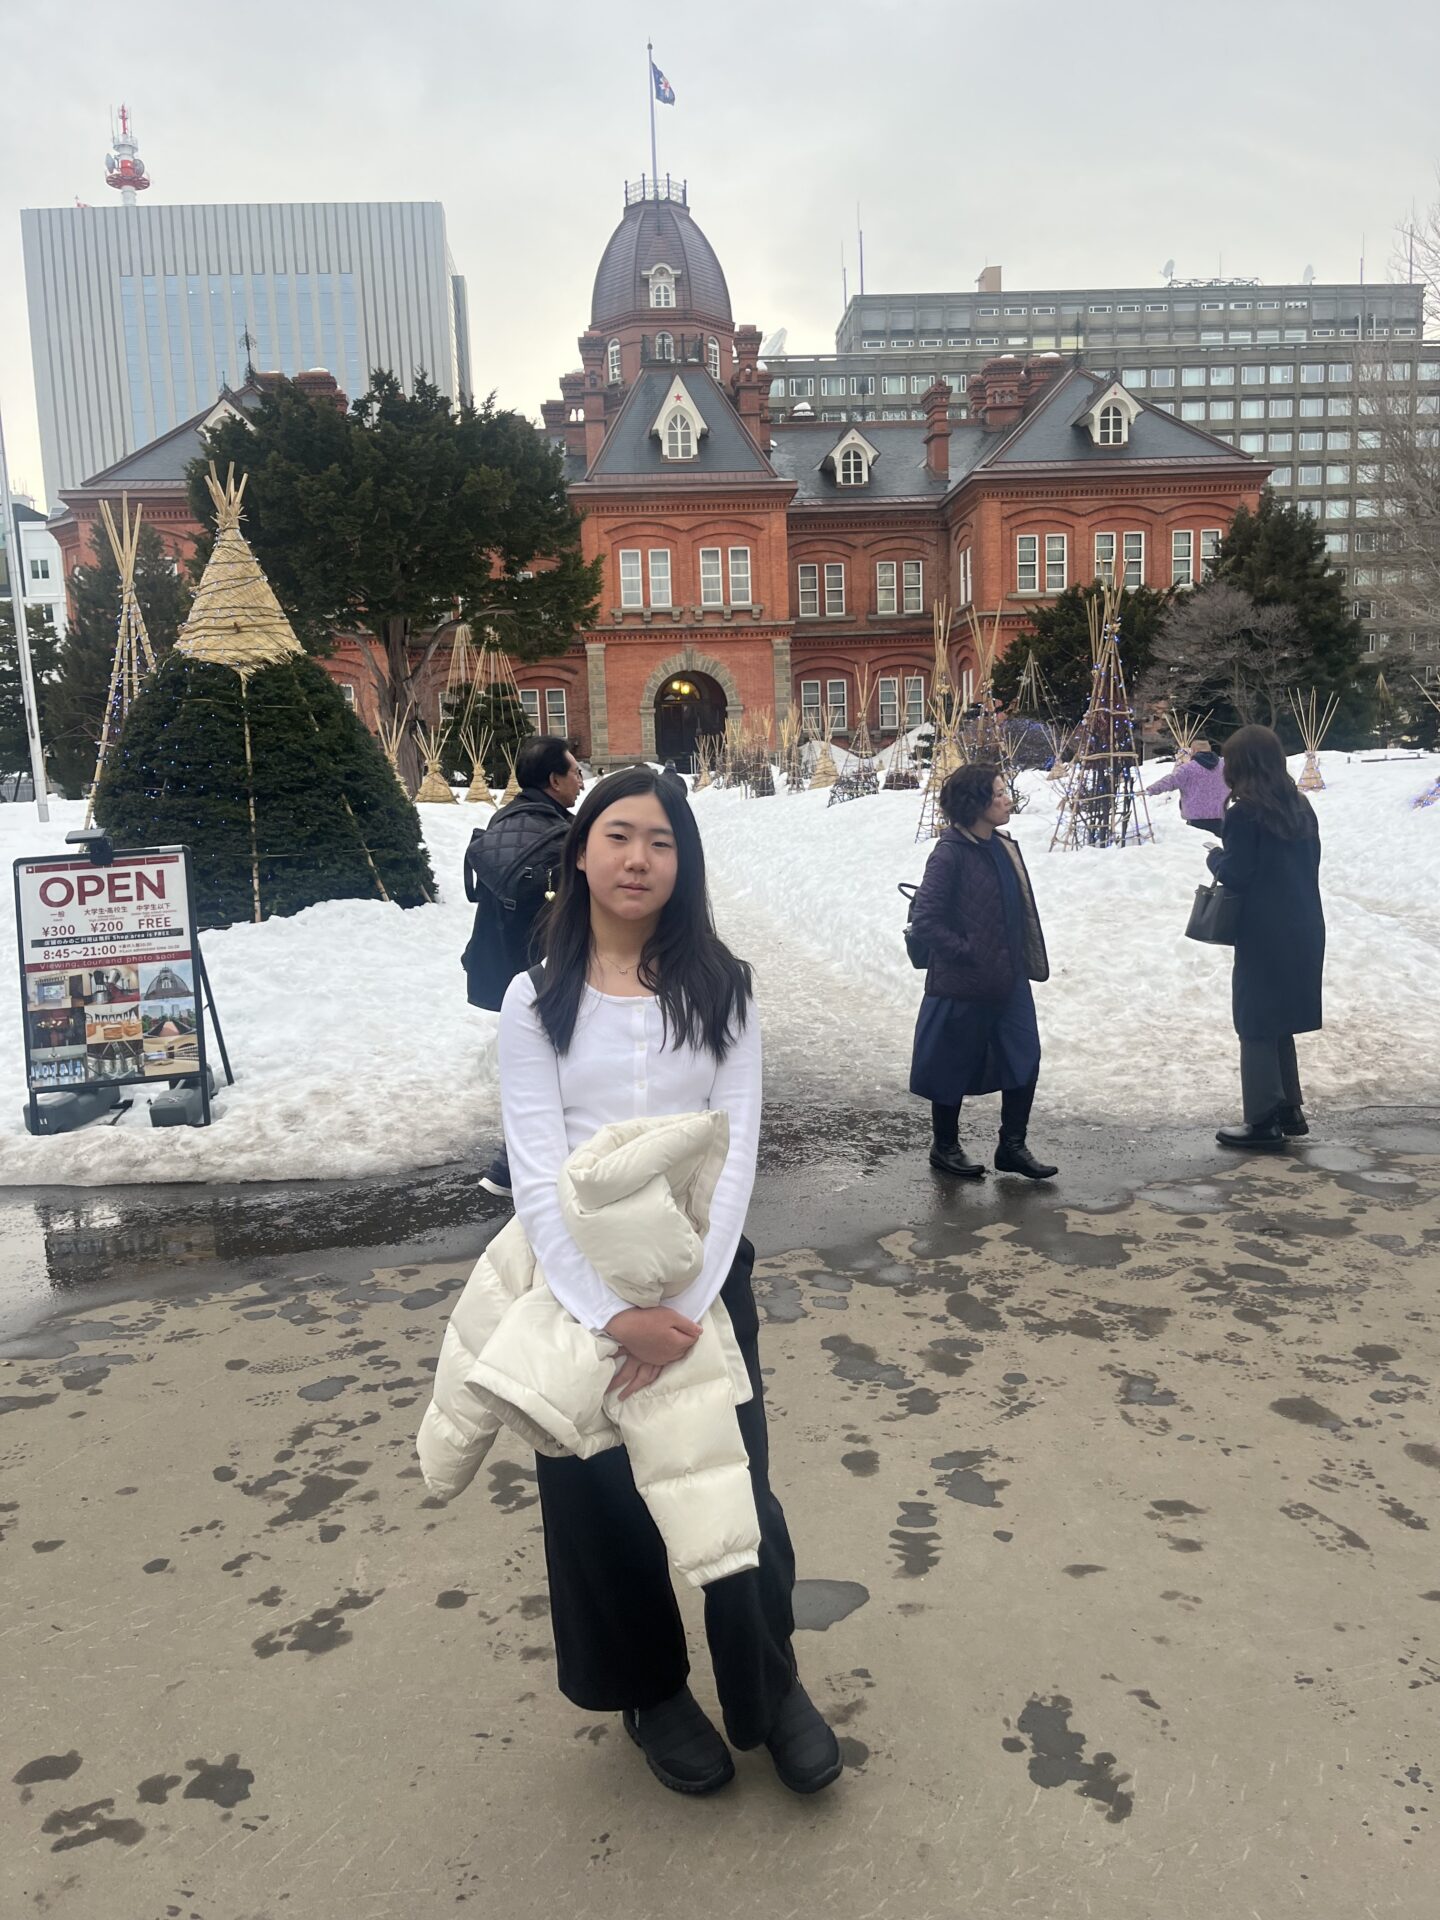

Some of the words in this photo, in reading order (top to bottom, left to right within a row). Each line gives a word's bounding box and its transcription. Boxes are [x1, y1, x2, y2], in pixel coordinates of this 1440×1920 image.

[39, 869, 166, 908] OPEN
[136, 902, 171, 912] 中学生以下
[90, 921, 124, 933] ¥200
[138, 917, 172, 930] FREE
[42, 925, 75, 937] ¥300
[39, 962, 80, 970] Viewing,
[105, 956, 123, 964] and
[126, 955, 153, 963] photo
[156, 953, 176, 962] spot
